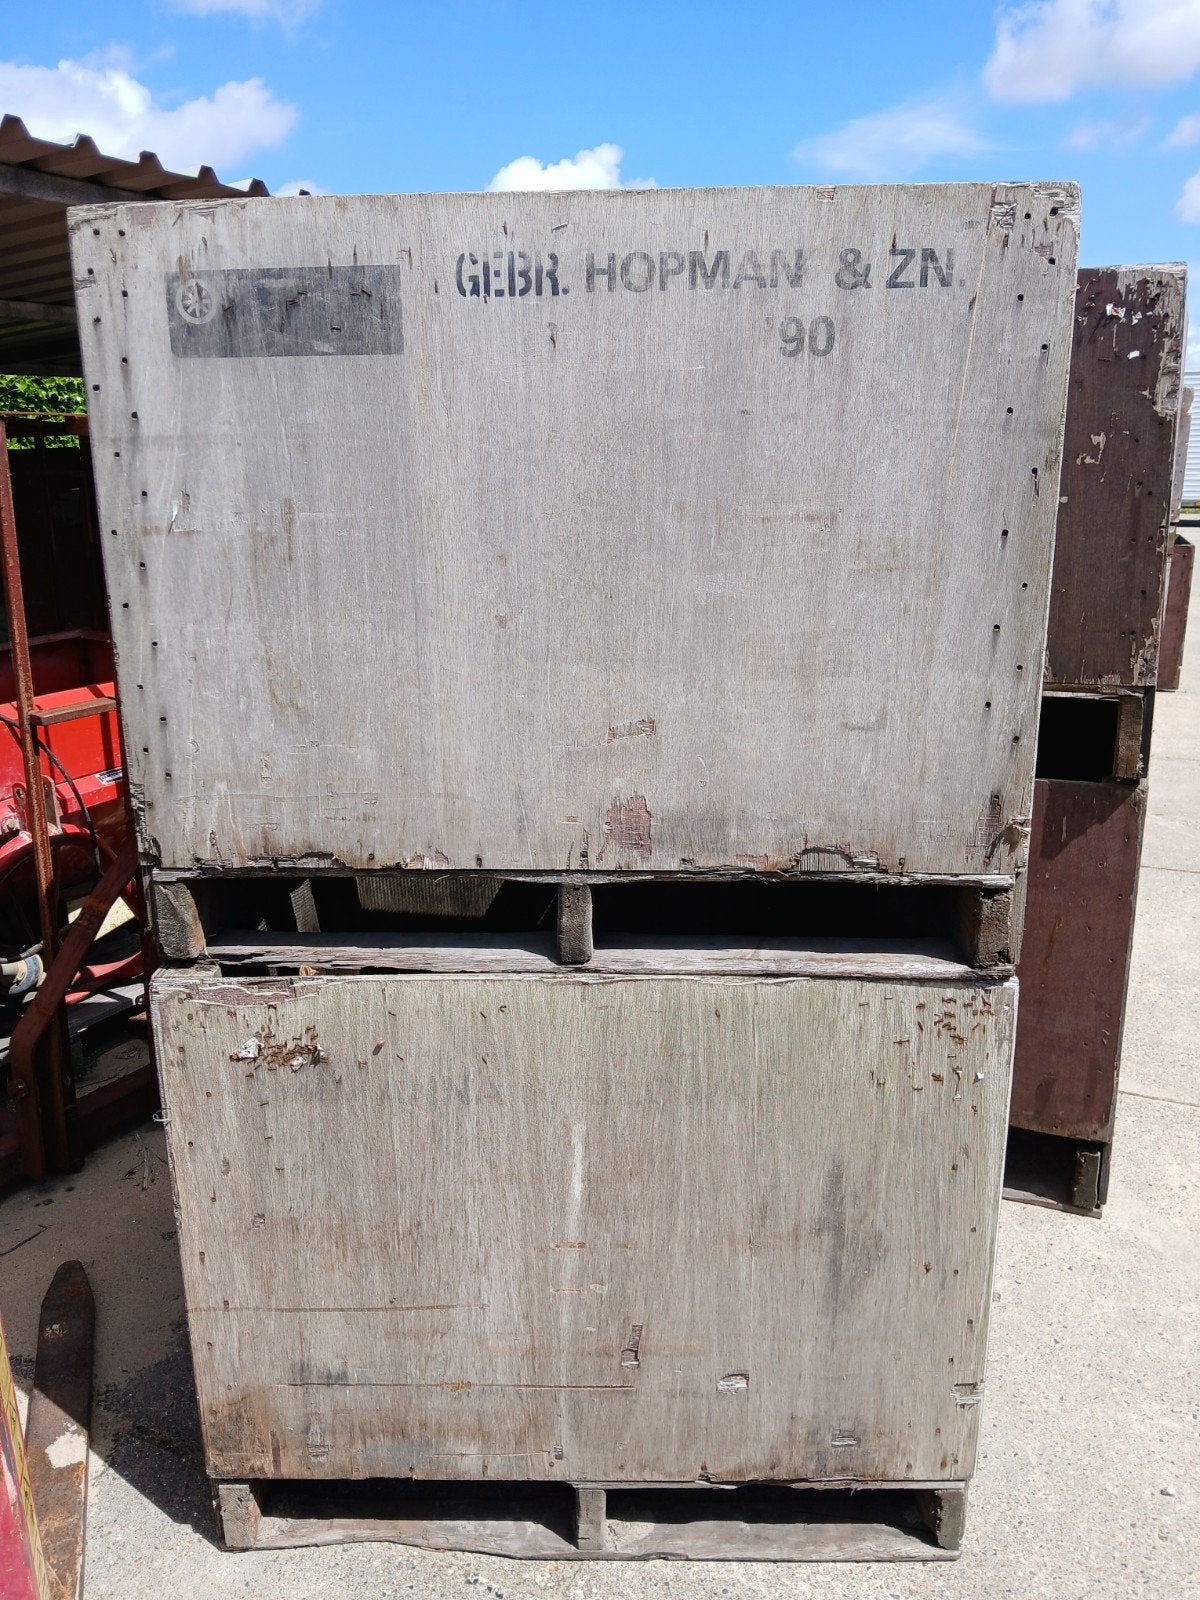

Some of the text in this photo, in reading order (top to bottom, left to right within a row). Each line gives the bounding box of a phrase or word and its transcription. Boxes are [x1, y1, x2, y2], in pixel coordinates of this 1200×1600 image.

[456, 248, 964, 297] GEBR. HOPMAN & ZN.
